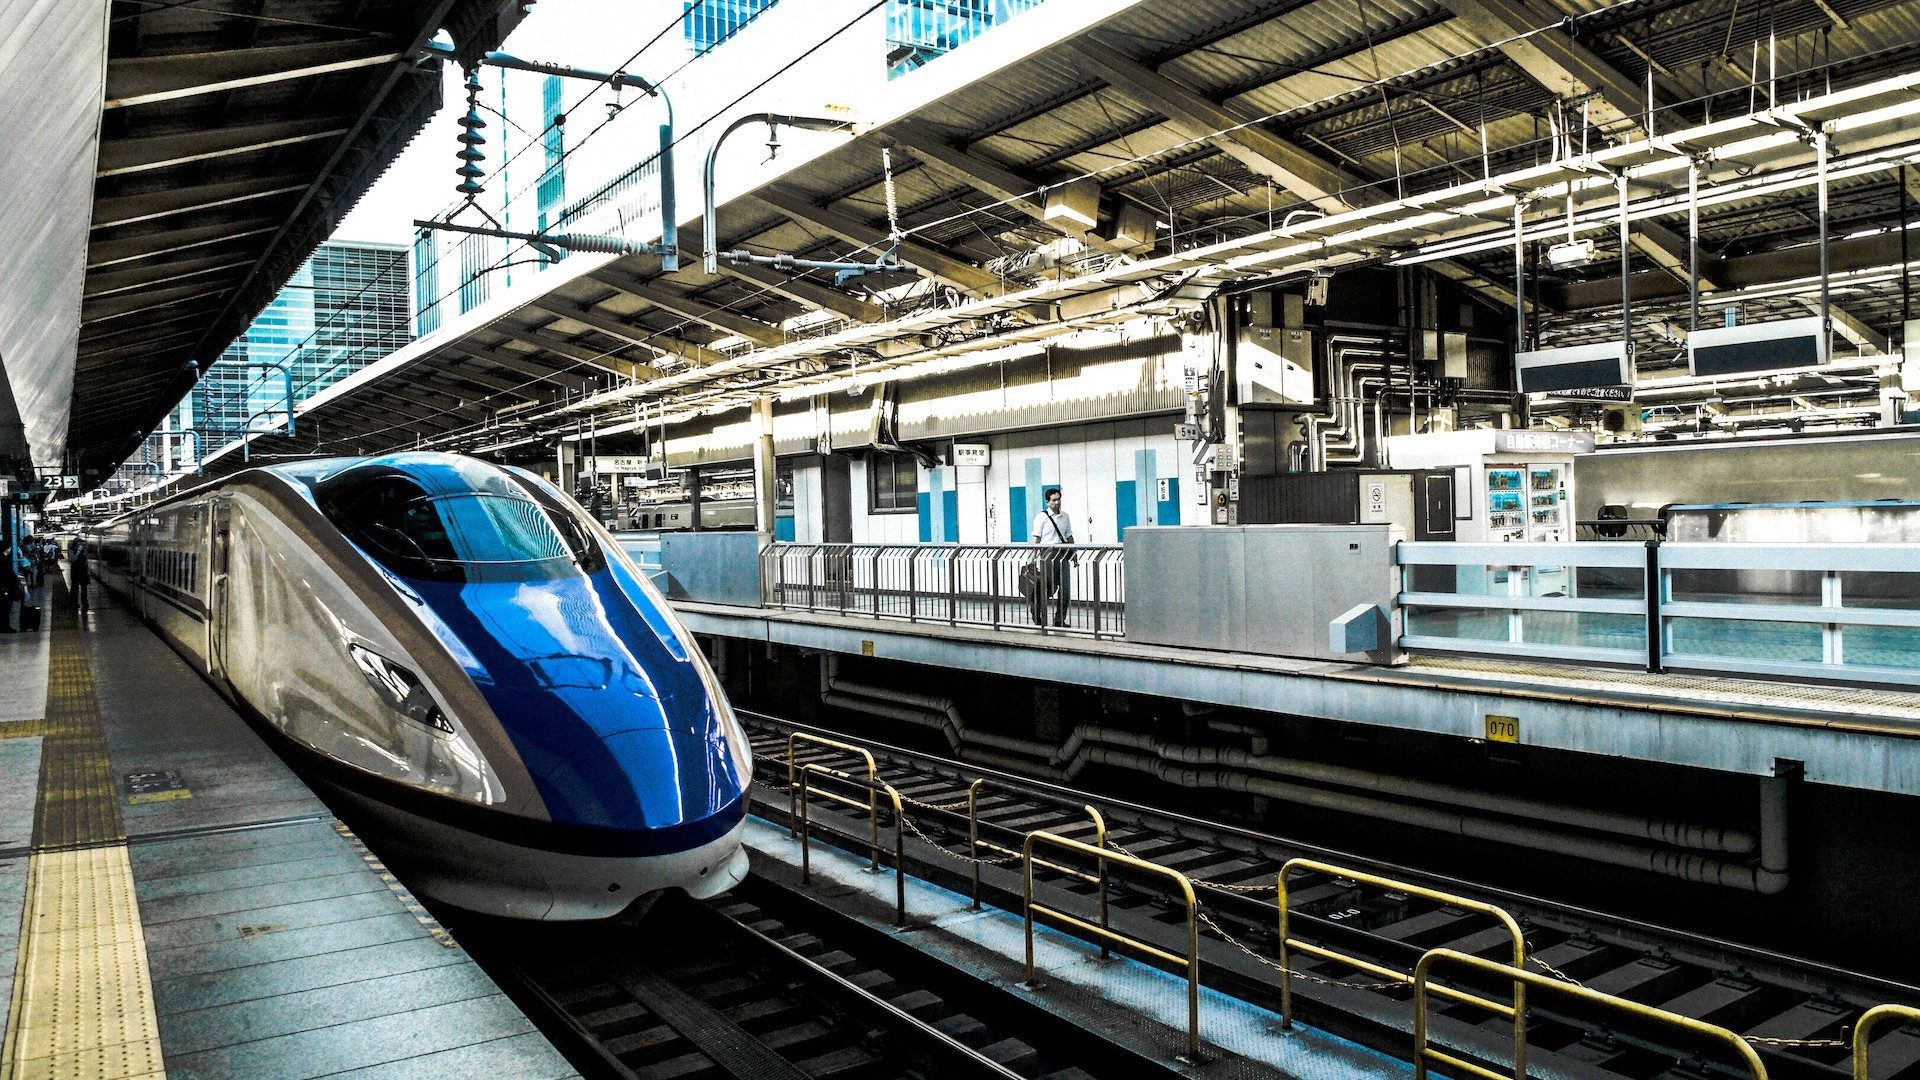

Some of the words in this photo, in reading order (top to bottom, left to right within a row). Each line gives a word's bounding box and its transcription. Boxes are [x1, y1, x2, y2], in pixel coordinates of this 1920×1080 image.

[1825, 320, 1831, 331] 4
[44, 476, 62, 488] 23
[1490, 721, 1514, 737] 070
